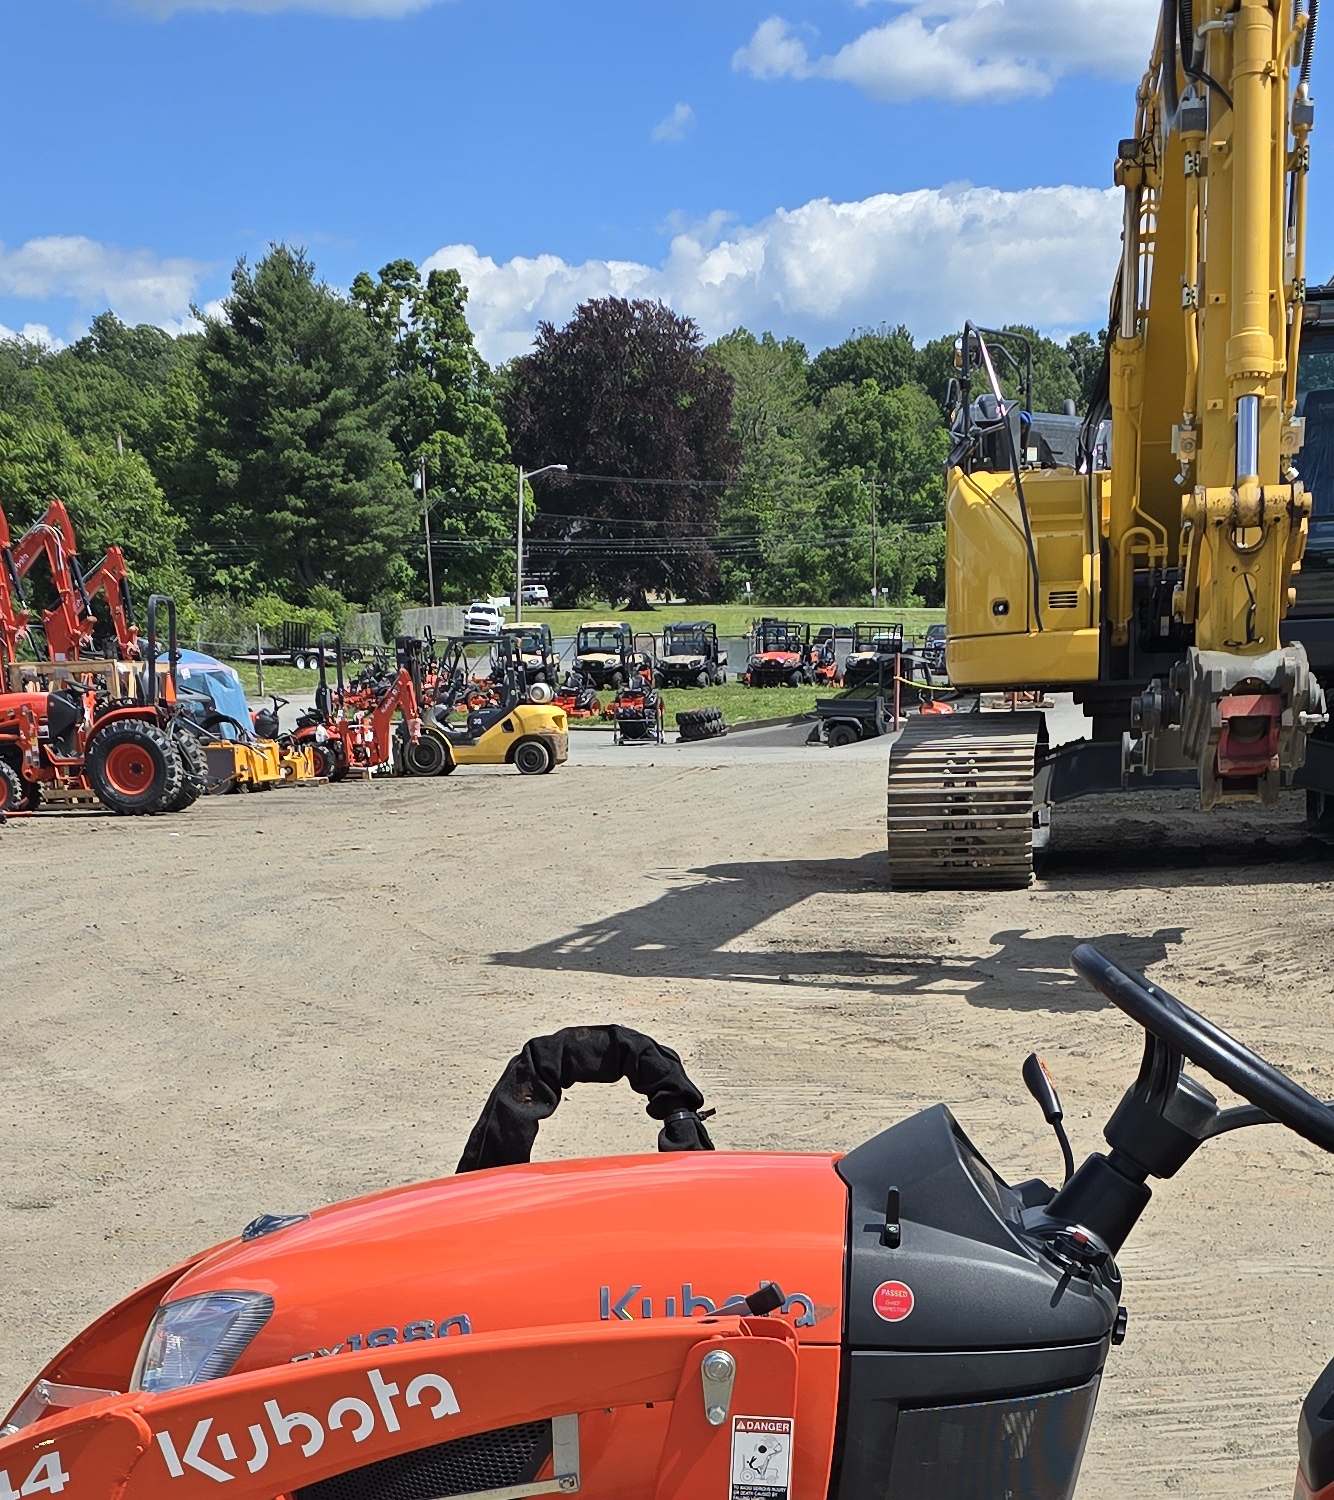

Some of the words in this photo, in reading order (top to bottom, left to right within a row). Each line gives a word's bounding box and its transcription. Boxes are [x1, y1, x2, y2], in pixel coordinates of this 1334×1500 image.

[599, 1280, 816, 1328] Kuba
[156, 1369, 461, 1482] Kubota
[746, 1421, 790, 1432] DANGER
